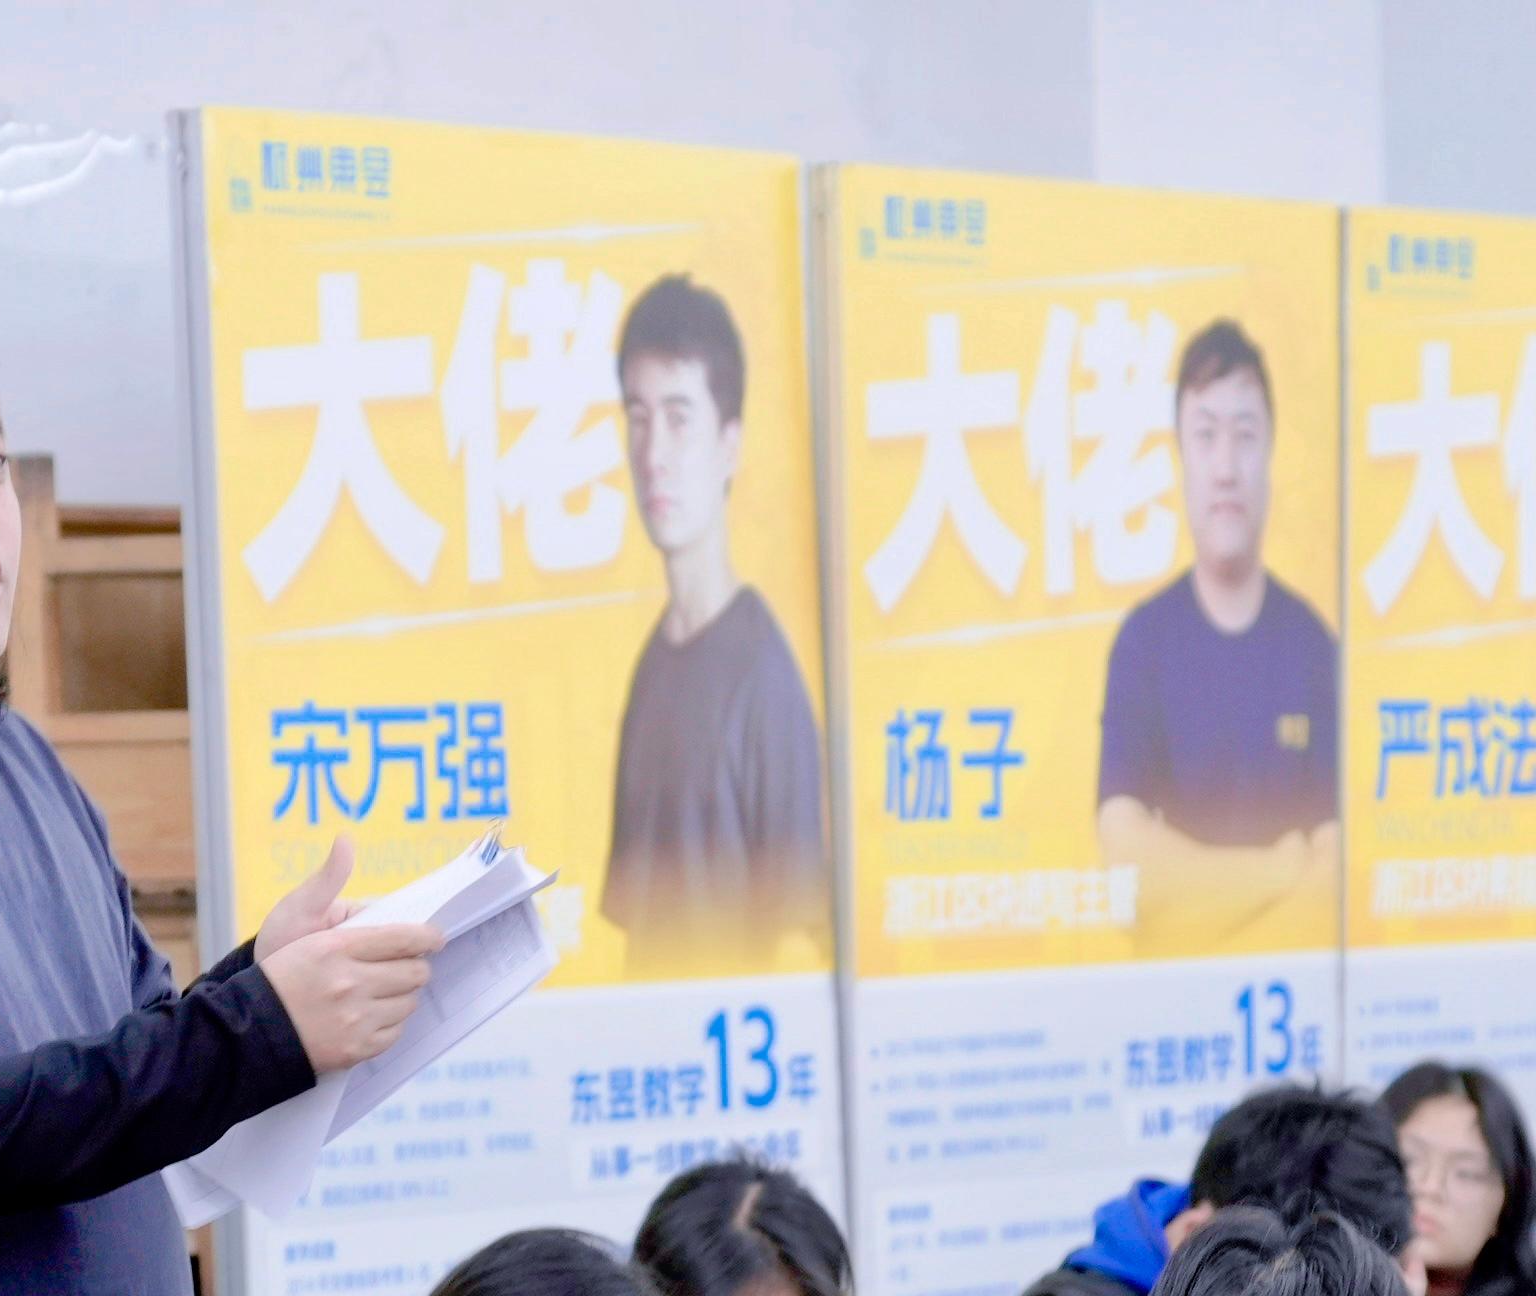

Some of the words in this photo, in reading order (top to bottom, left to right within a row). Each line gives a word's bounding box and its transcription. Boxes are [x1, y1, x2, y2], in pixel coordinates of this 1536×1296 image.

[241, 257, 626, 603] 大佬
[863, 300, 1178, 616] 大佬
[270, 701, 510, 824] 宋万强
[884, 708, 1025, 822] 杨子
